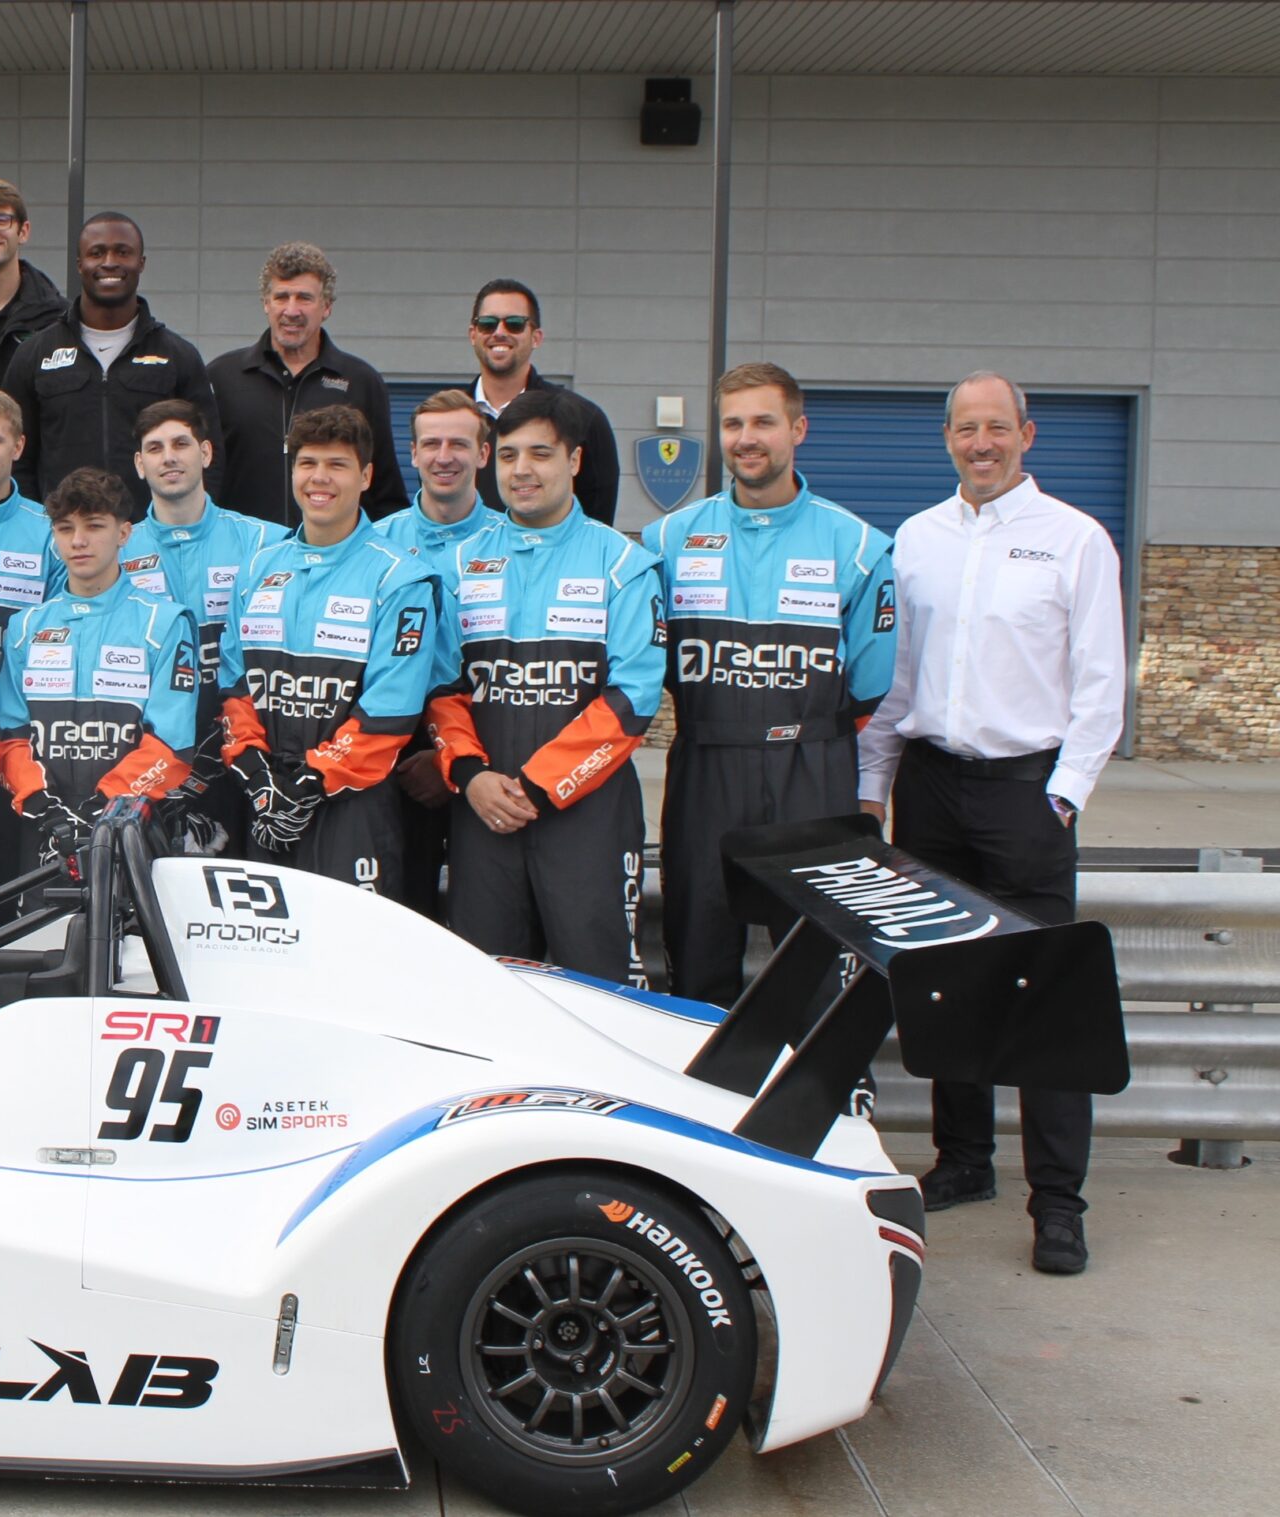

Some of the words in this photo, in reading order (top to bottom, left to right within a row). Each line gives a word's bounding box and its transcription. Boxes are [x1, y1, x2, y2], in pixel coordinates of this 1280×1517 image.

[693, 536, 724, 547] MPI
[473, 561, 503, 572] MPI
[37, 630, 65, 642] MPI
[790, 856, 973, 938] PRIMAL
[196, 943, 239, 952] RACING
[243, 945, 290, 955] LEAGUE
[100, 1011, 216, 1045] SR1
[97, 1047, 213, 1144] 95
[262, 1100, 329, 1113] ASETEK
